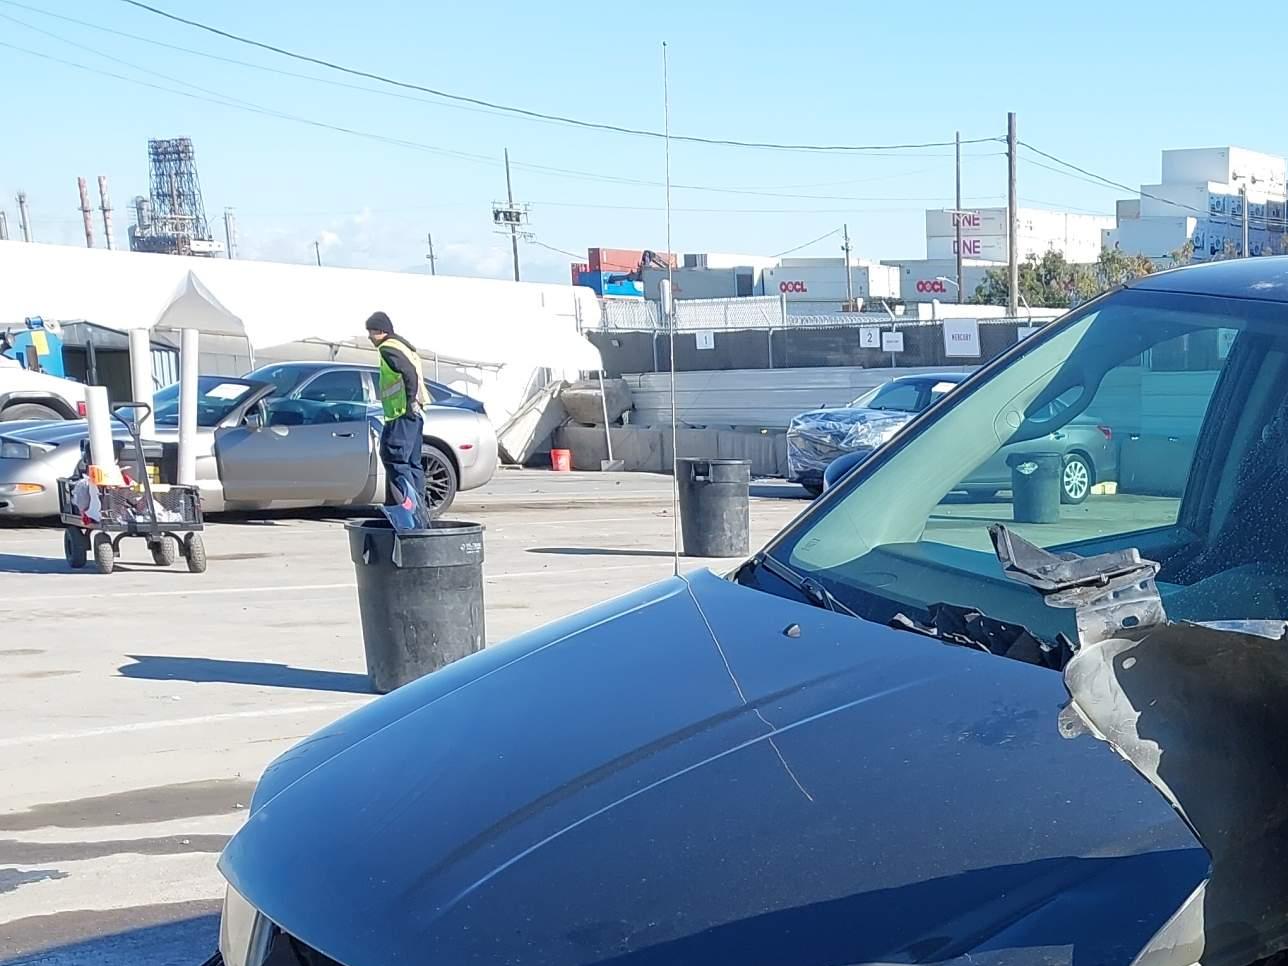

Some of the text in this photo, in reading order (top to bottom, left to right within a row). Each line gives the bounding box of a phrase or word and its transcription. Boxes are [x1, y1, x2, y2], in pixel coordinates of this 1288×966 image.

[779, 281, 808, 293] OOCL
[916, 281, 947, 293] OOCL
[866, 332, 873, 344] 2
